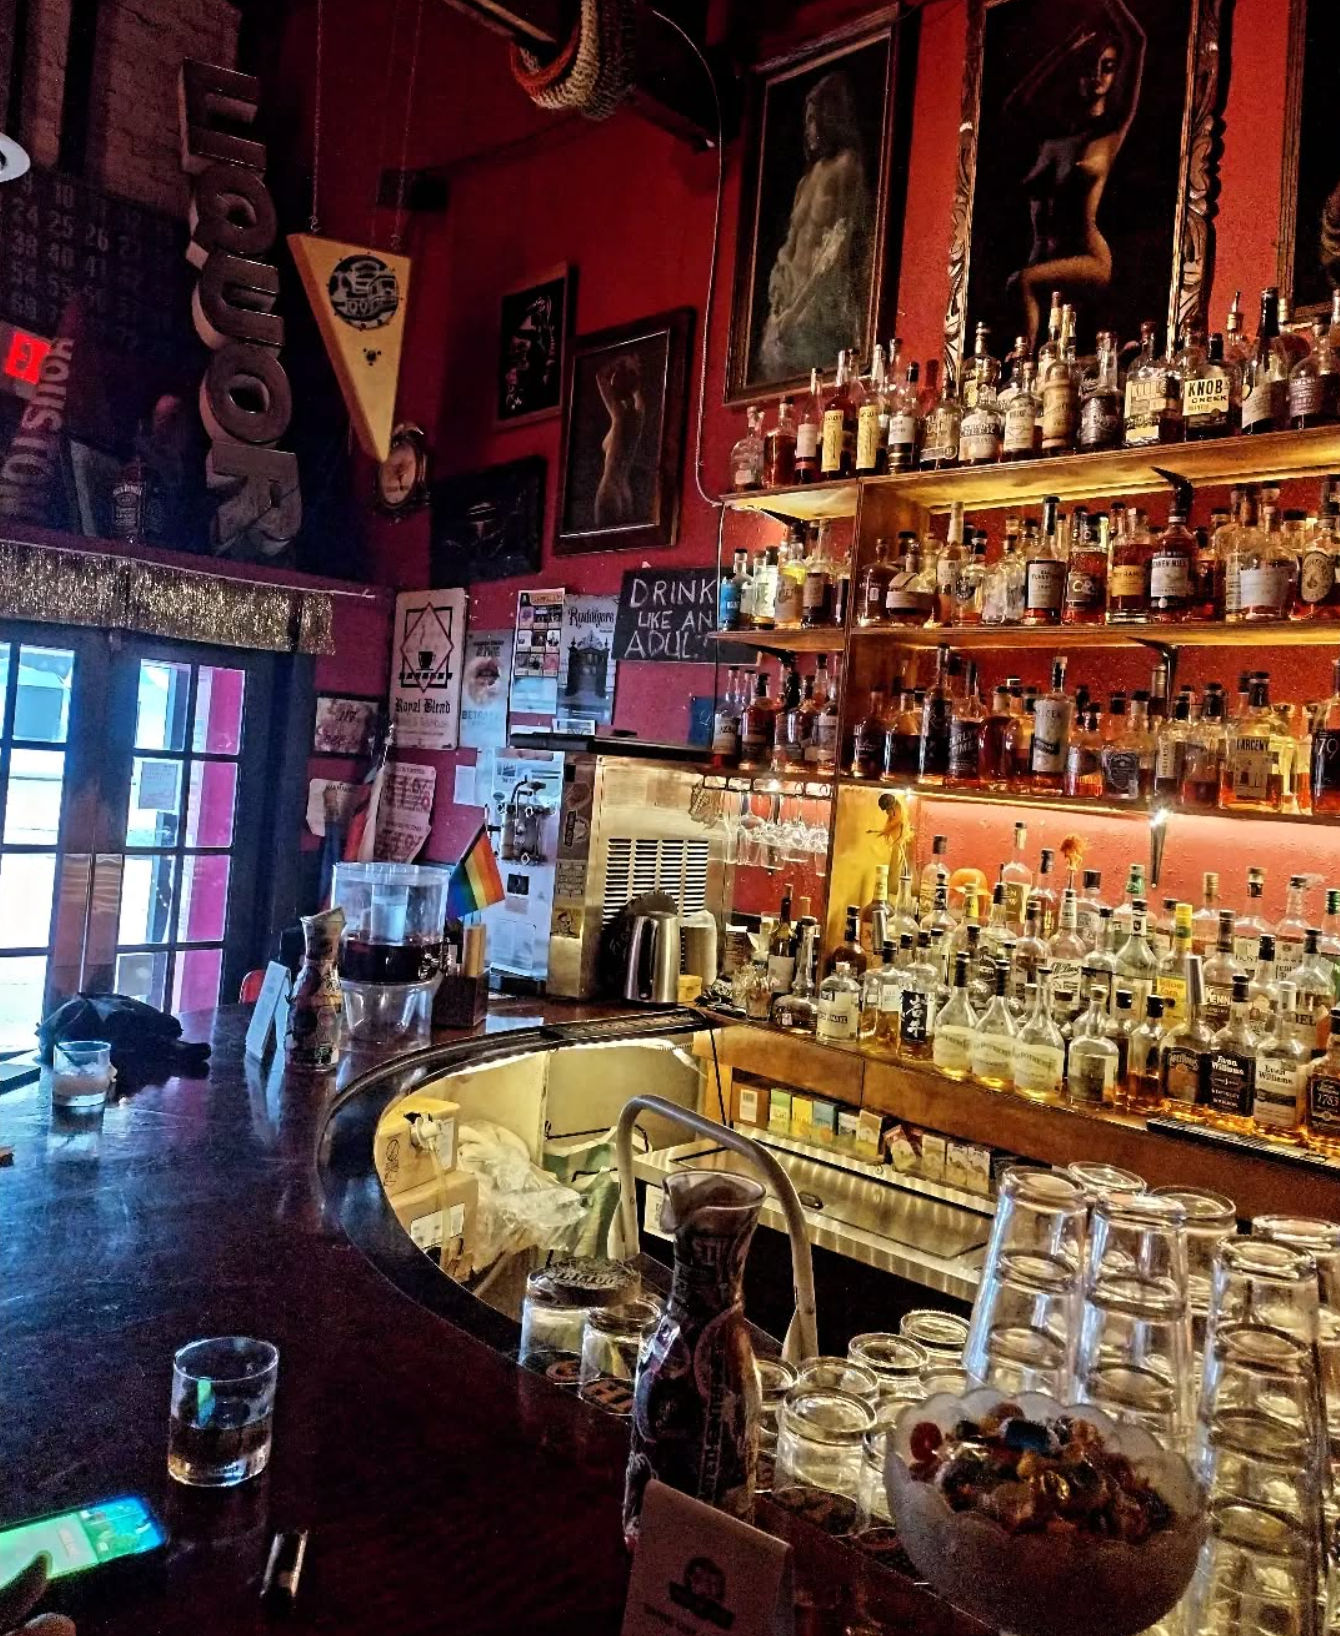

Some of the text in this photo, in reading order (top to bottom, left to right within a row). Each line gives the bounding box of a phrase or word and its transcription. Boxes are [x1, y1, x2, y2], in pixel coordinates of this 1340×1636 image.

[177, 57, 303, 557] LIQUOR
[1188, 379, 1223, 397] KNOB
[630, 578, 717, 608] DRINK
[638, 610, 713, 632] LIKE AN
[424, 698, 451, 715] Blend
